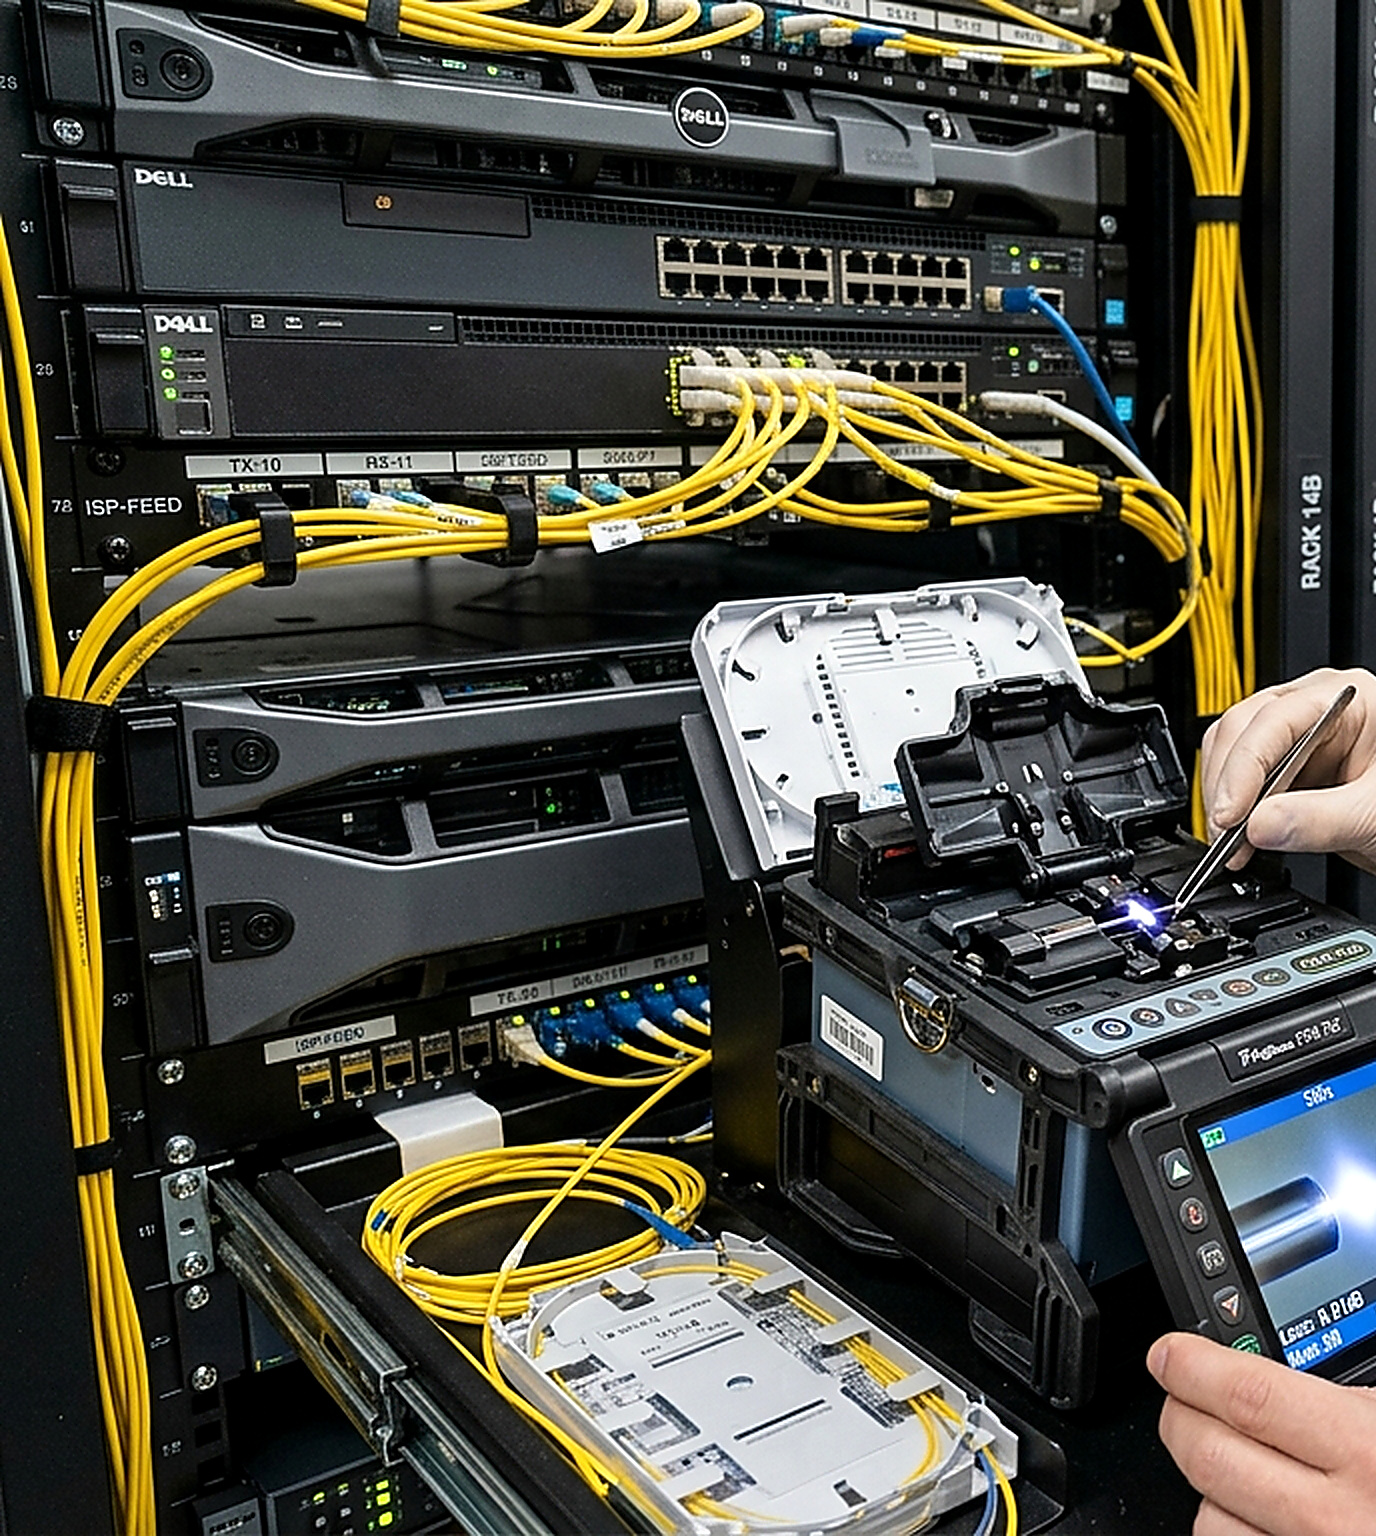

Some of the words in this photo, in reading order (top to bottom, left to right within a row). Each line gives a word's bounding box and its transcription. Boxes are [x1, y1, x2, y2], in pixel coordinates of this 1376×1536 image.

[229, 457, 282, 473] TX-10
[1301, 474, 1322, 519] 14B
[51, 500, 73, 513] 78
[86, 497, 182, 516] ISP-FEED
[1301, 524, 1321, 589] RACK
